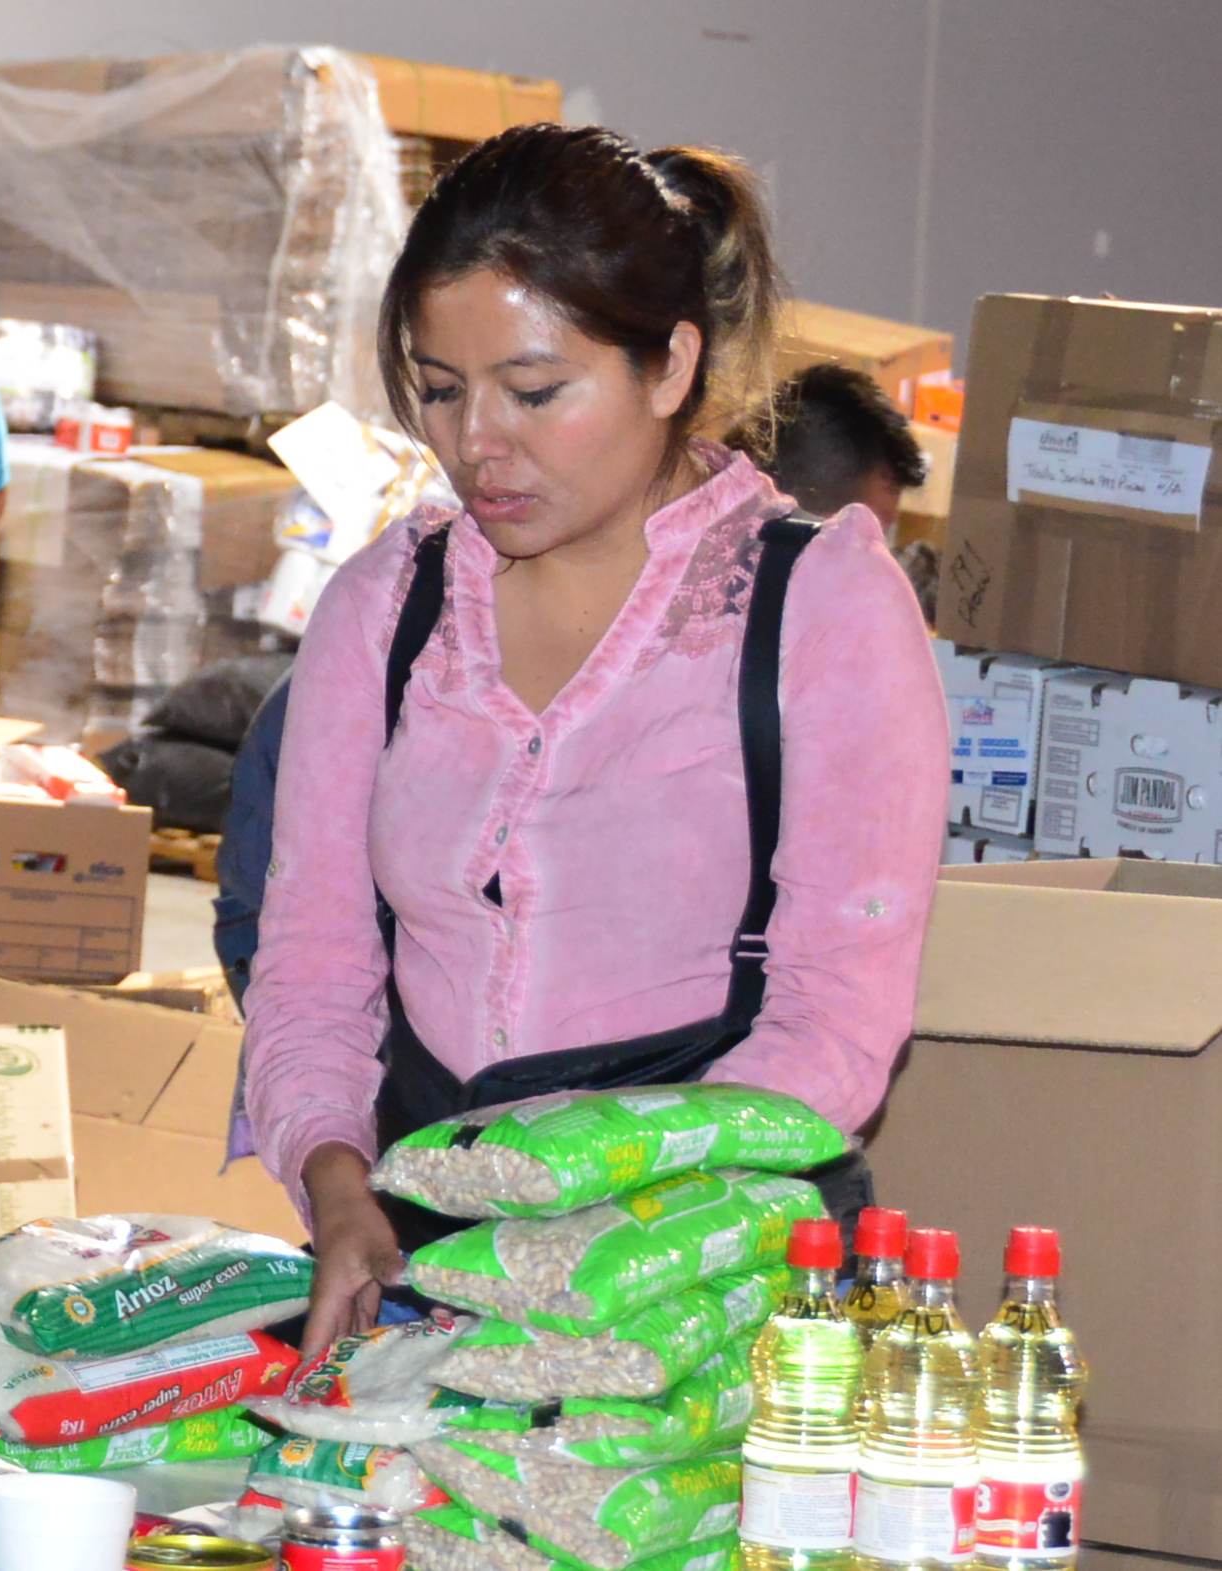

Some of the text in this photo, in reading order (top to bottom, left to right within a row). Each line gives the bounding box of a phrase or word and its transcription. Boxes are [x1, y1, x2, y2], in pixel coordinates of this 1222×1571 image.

[114, 1260, 249, 1319] Arroz super extra
[141, 1384, 182, 1416] super
